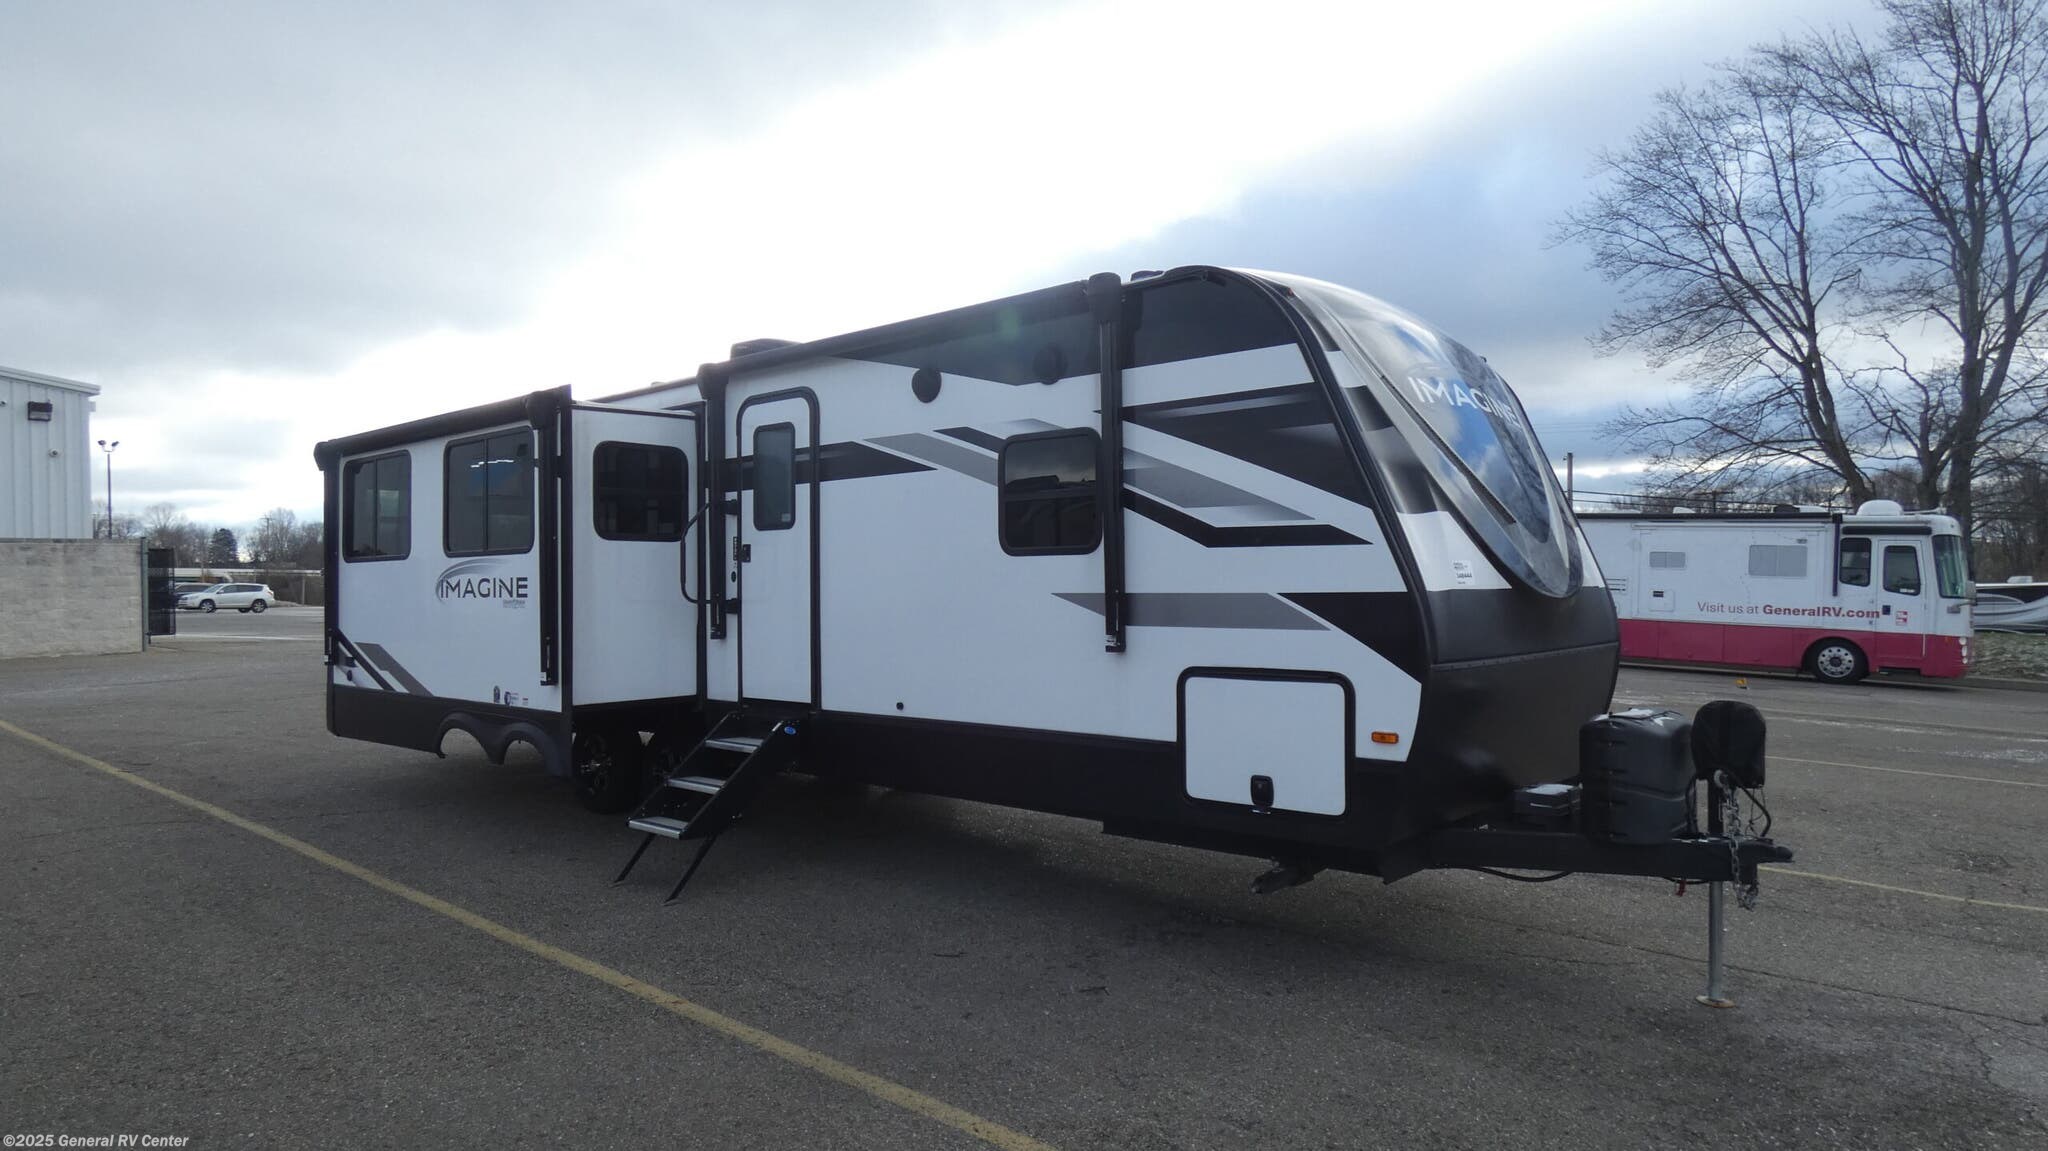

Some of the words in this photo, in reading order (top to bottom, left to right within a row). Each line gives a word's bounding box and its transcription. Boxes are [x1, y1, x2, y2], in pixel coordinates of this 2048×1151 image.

[1407, 376, 1521, 428] IMAGINE
[440, 577, 528, 598] IMAGINE
[1697, 601, 1725, 613] Visit
[1728, 604, 1743, 614] us
[1746, 605, 1759, 614] at
[1762, 604, 1880, 619] GeneralRV.com
